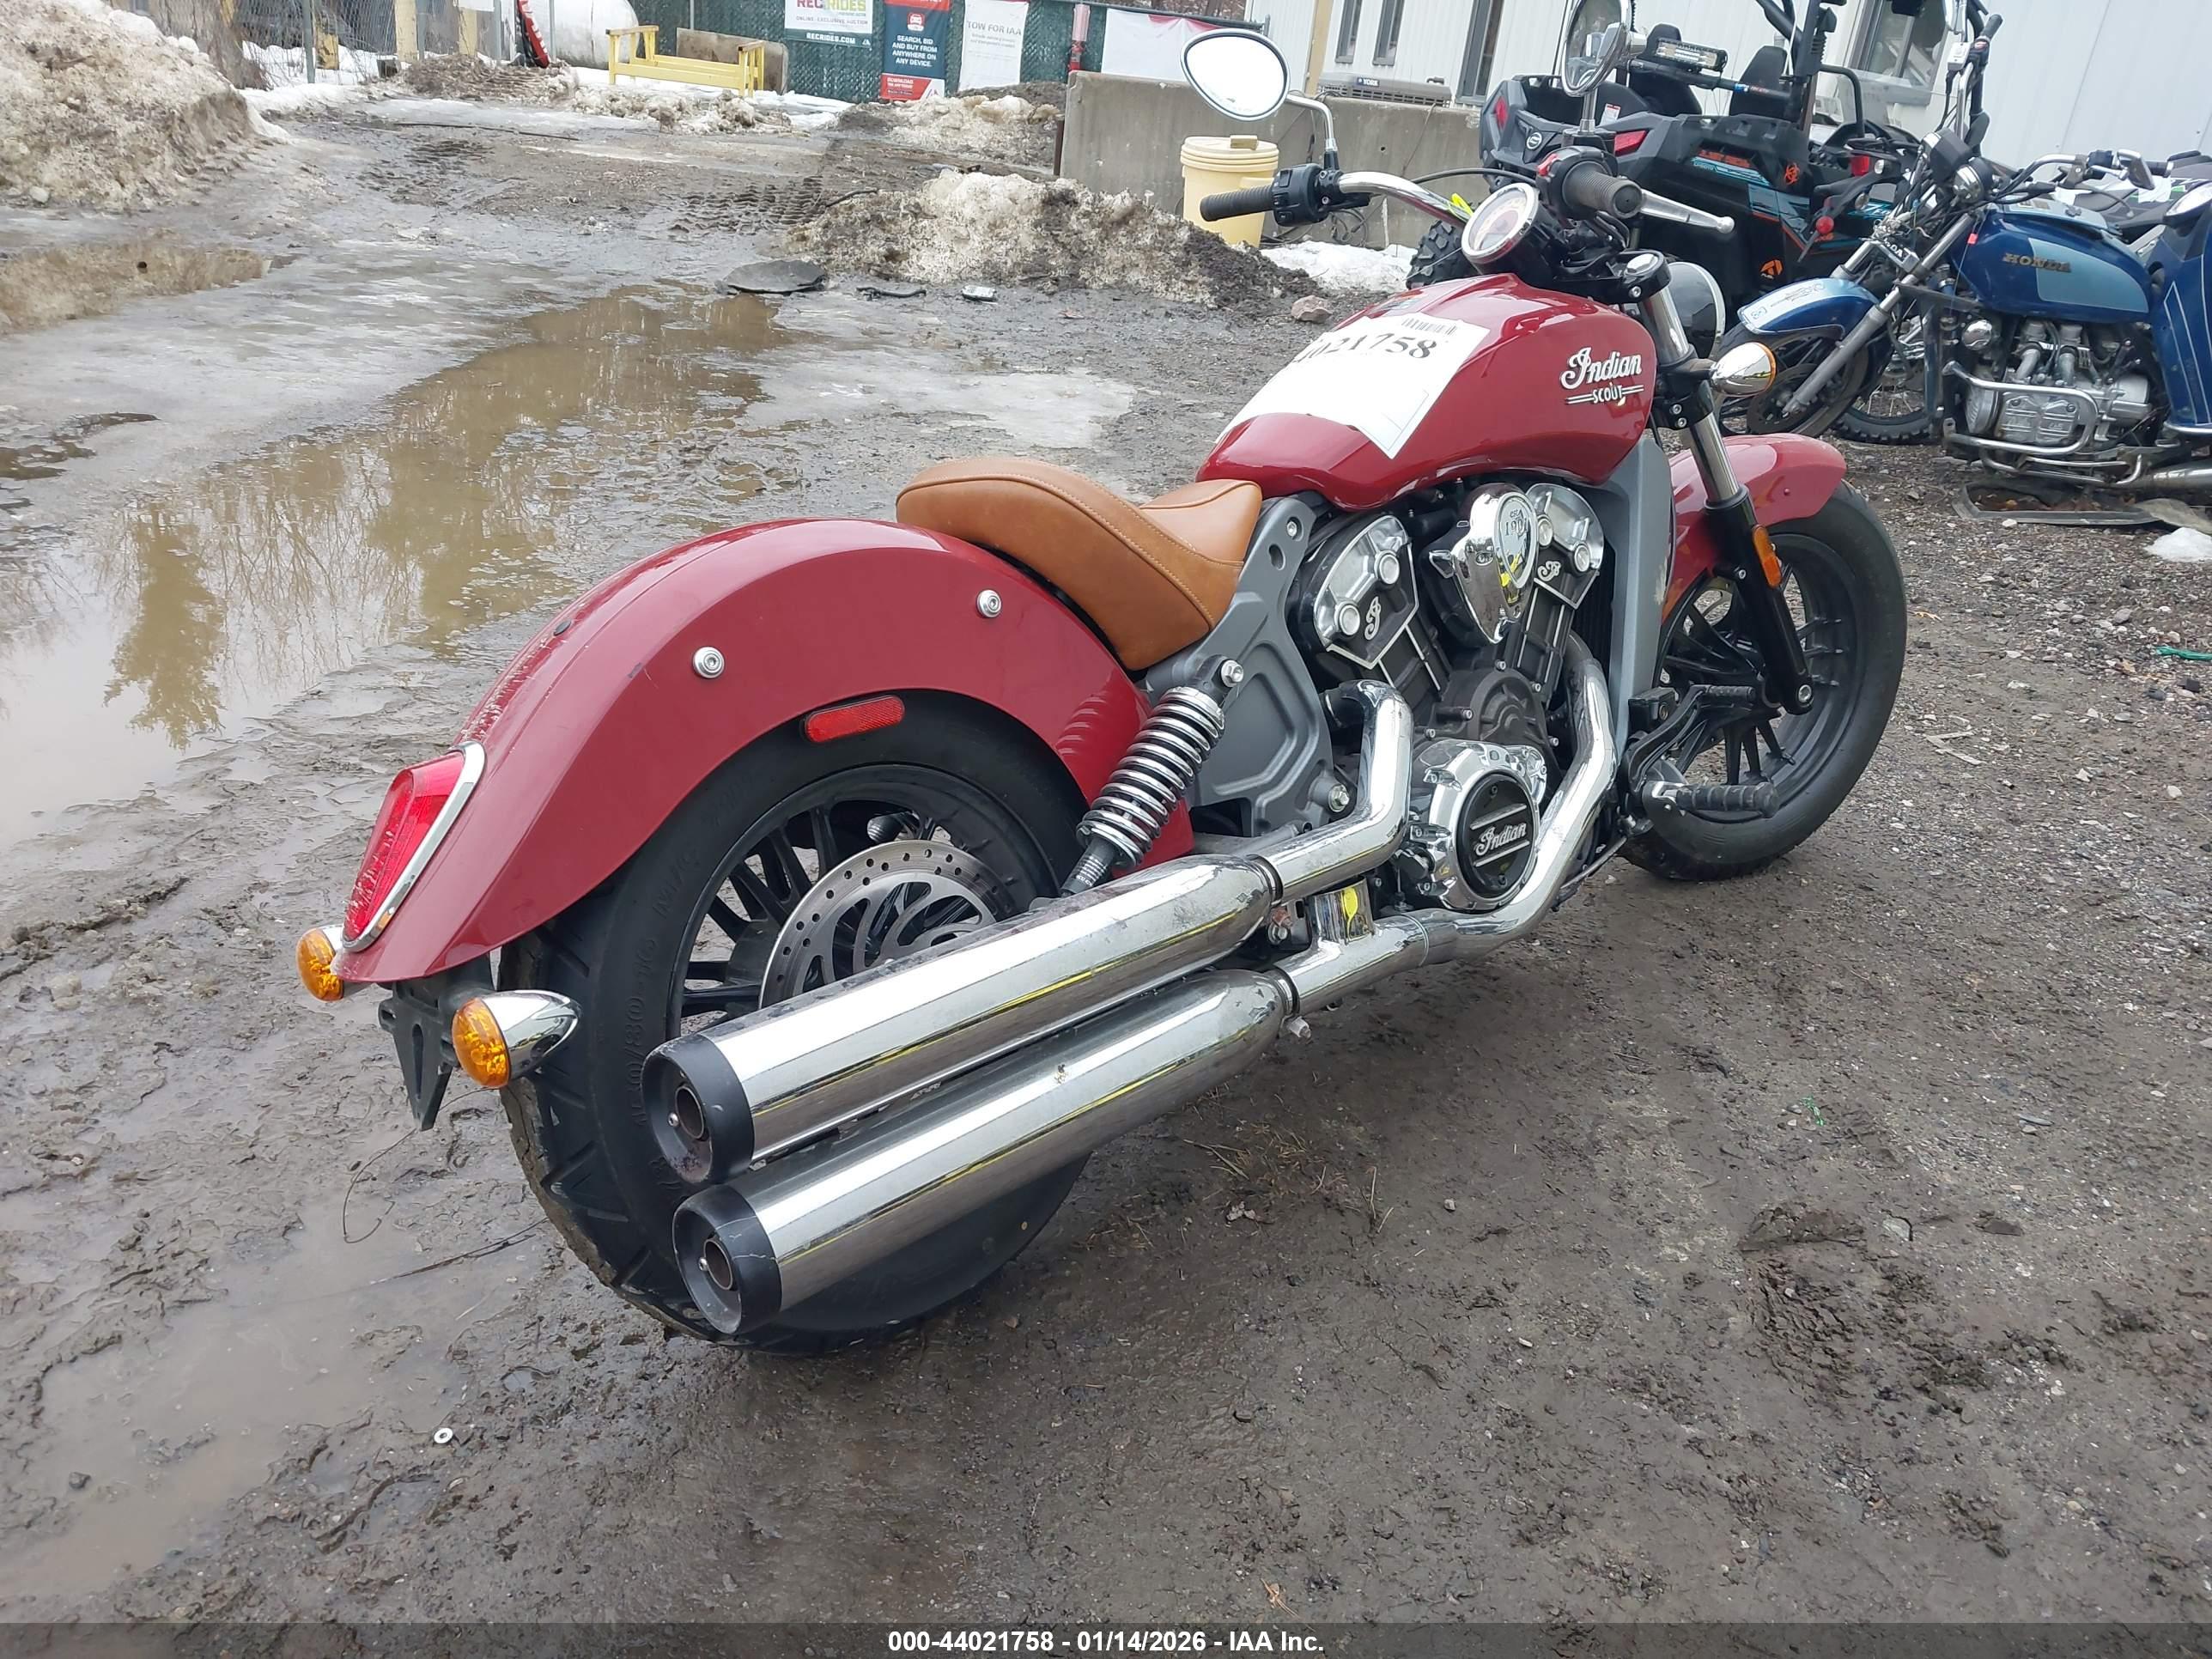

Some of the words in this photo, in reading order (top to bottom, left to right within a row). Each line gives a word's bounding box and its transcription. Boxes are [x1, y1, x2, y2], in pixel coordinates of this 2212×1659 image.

[967, 20, 986, 31] TOW
[988, 23, 1004, 33] FOR
[1006, 27, 1022, 35] IAA
[805, 32, 856, 45] RECRIDES.COM
[896, 34, 922, 45] SEARCH,
[891, 49, 927, 59] ANYWHERE
[920, 45, 938, 53] FROM
[895, 57, 909, 65] ANY
[909, 59, 933, 68] DEVICE.
[2002, 252, 2071, 272] HONDA
[1560, 347, 1643, 390] Indian
[1592, 384, 1624, 404] SCOUT
[1474, 822, 1528, 857] Indian
